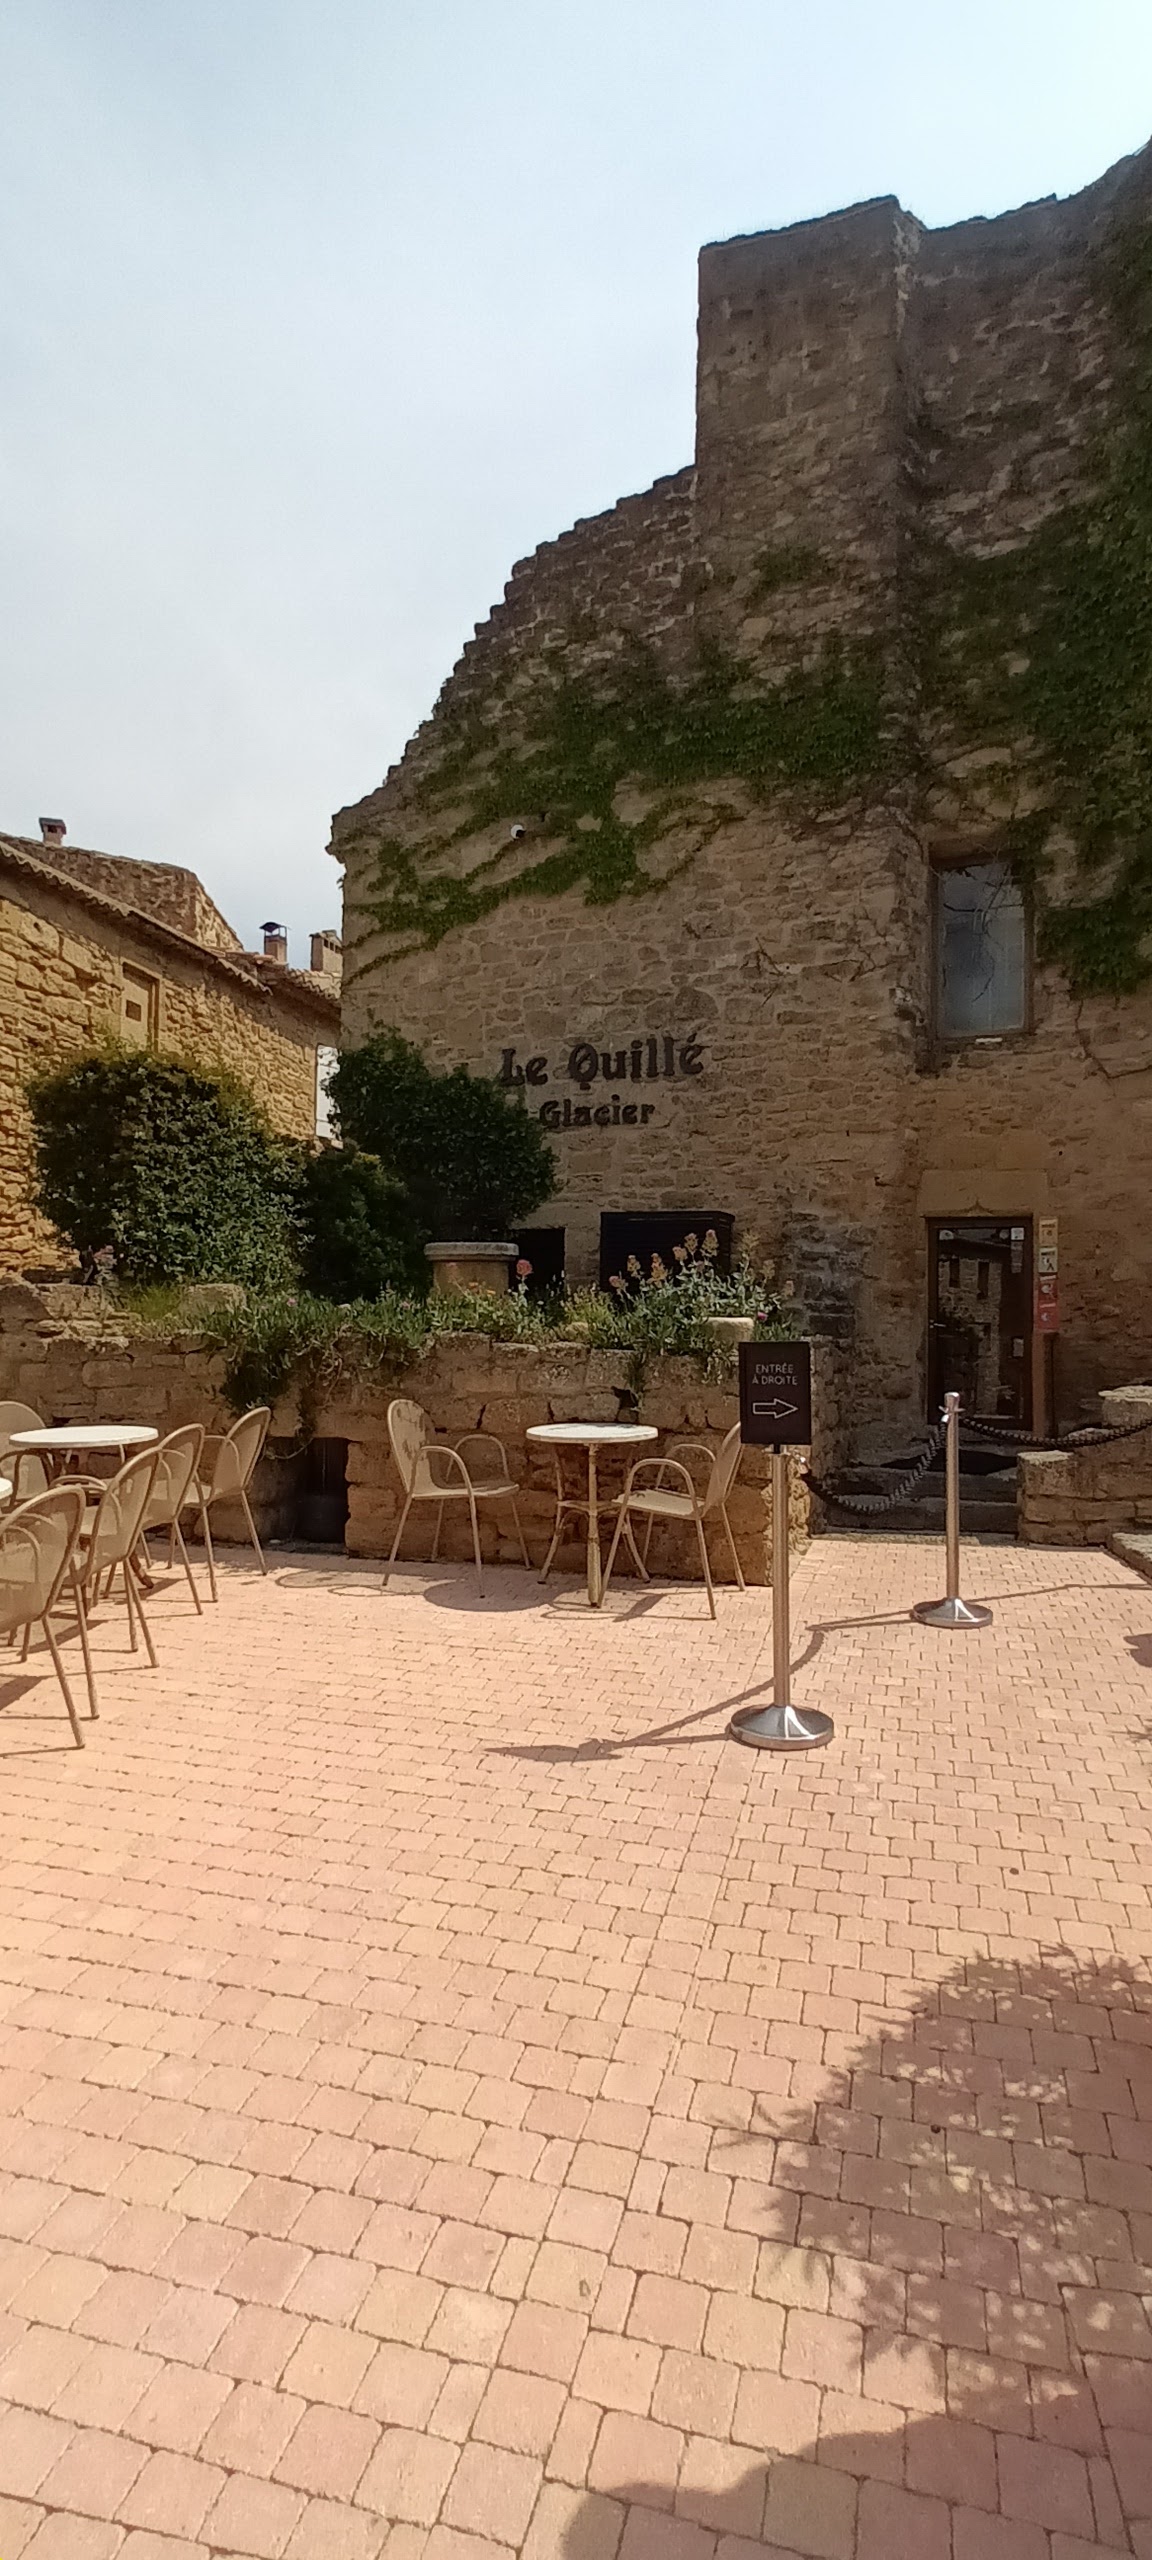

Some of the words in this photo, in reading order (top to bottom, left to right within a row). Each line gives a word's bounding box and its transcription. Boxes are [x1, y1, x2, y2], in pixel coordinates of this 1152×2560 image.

[501, 1048, 549, 1087] Le
[567, 1032, 706, 1091] Quillé
[539, 1094, 656, 1129] Glacier
[752, 1374, 759, 1384] À
[761, 1375, 798, 1385] DROITE
[756, 1362, 793, 1374] ENTRÉE
